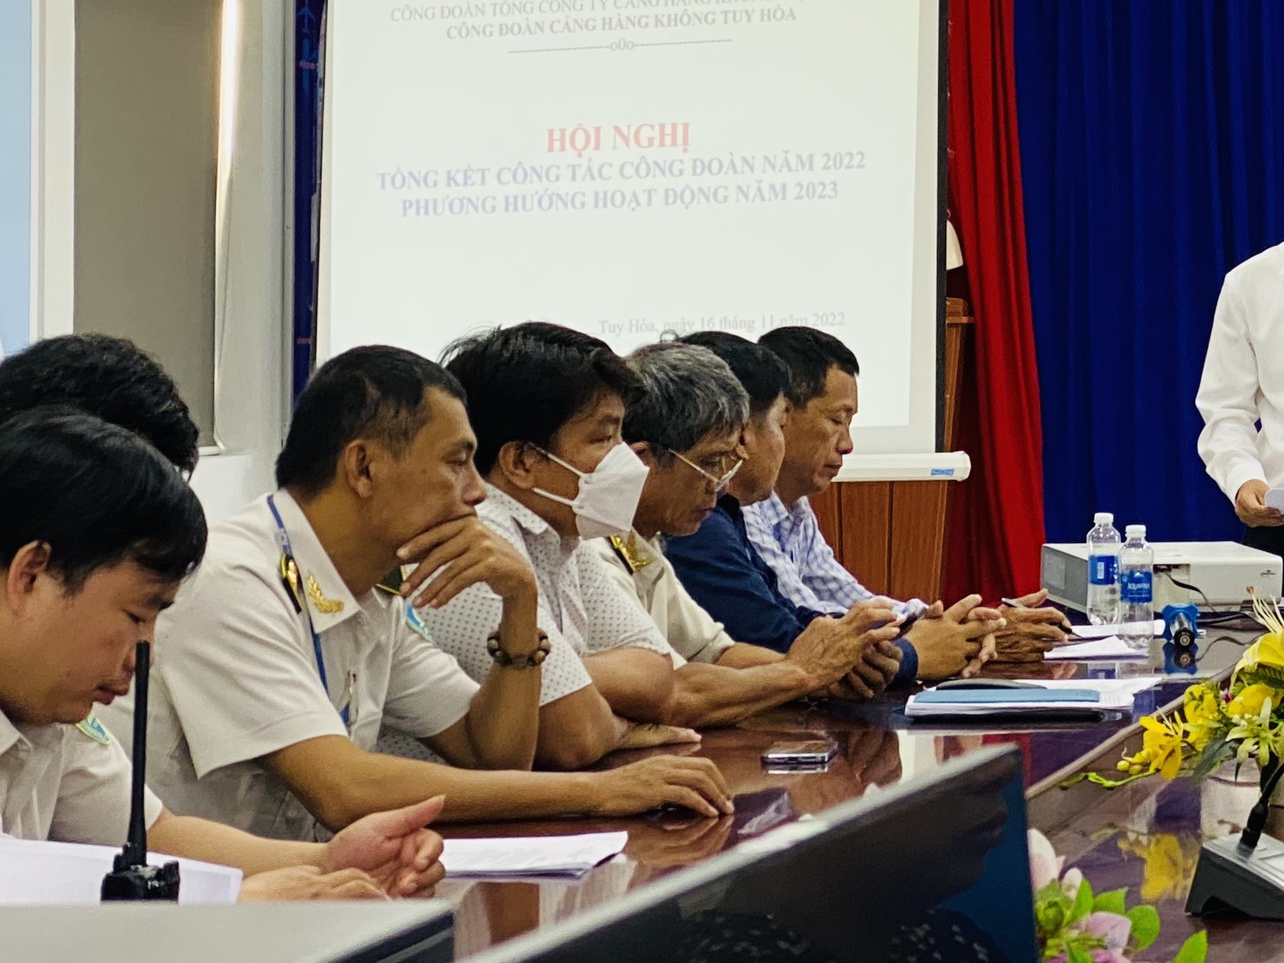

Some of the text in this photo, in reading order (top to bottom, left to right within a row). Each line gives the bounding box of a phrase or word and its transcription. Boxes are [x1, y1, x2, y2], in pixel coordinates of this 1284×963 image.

[390, 4, 436, 22] CÔNG
[446, 21, 494, 40] CÔNG
[499, 18, 545, 37] ĐOÀN
[601, 13, 650, 33] HÀNG
[654, 8, 716, 29] KHÔNG
[720, 8, 756, 25] TUY
[759, 4, 797, 23] HÒA
[546, 122, 691, 158] HỘI NGHỊ
[496, 161, 560, 185] CÔNG
[567, 158, 613, 182] TÁC
[618, 155, 684, 180] CÔNG
[691, 152, 756, 177] ĐOÀN
[762, 149, 815, 174] NĂM
[821, 151, 866, 170] 2022
[401, 179, 839, 217] PHƯƠNG HƯỚNG HOẠT ĐỘNG NĂM 2023
[598, 319, 624, 335] Tuy
[700, 317, 715, 330] 16
[719, 317, 756, 332] tháng
[760, 315, 775, 328] 11
[813, 312, 845, 327] 2022
